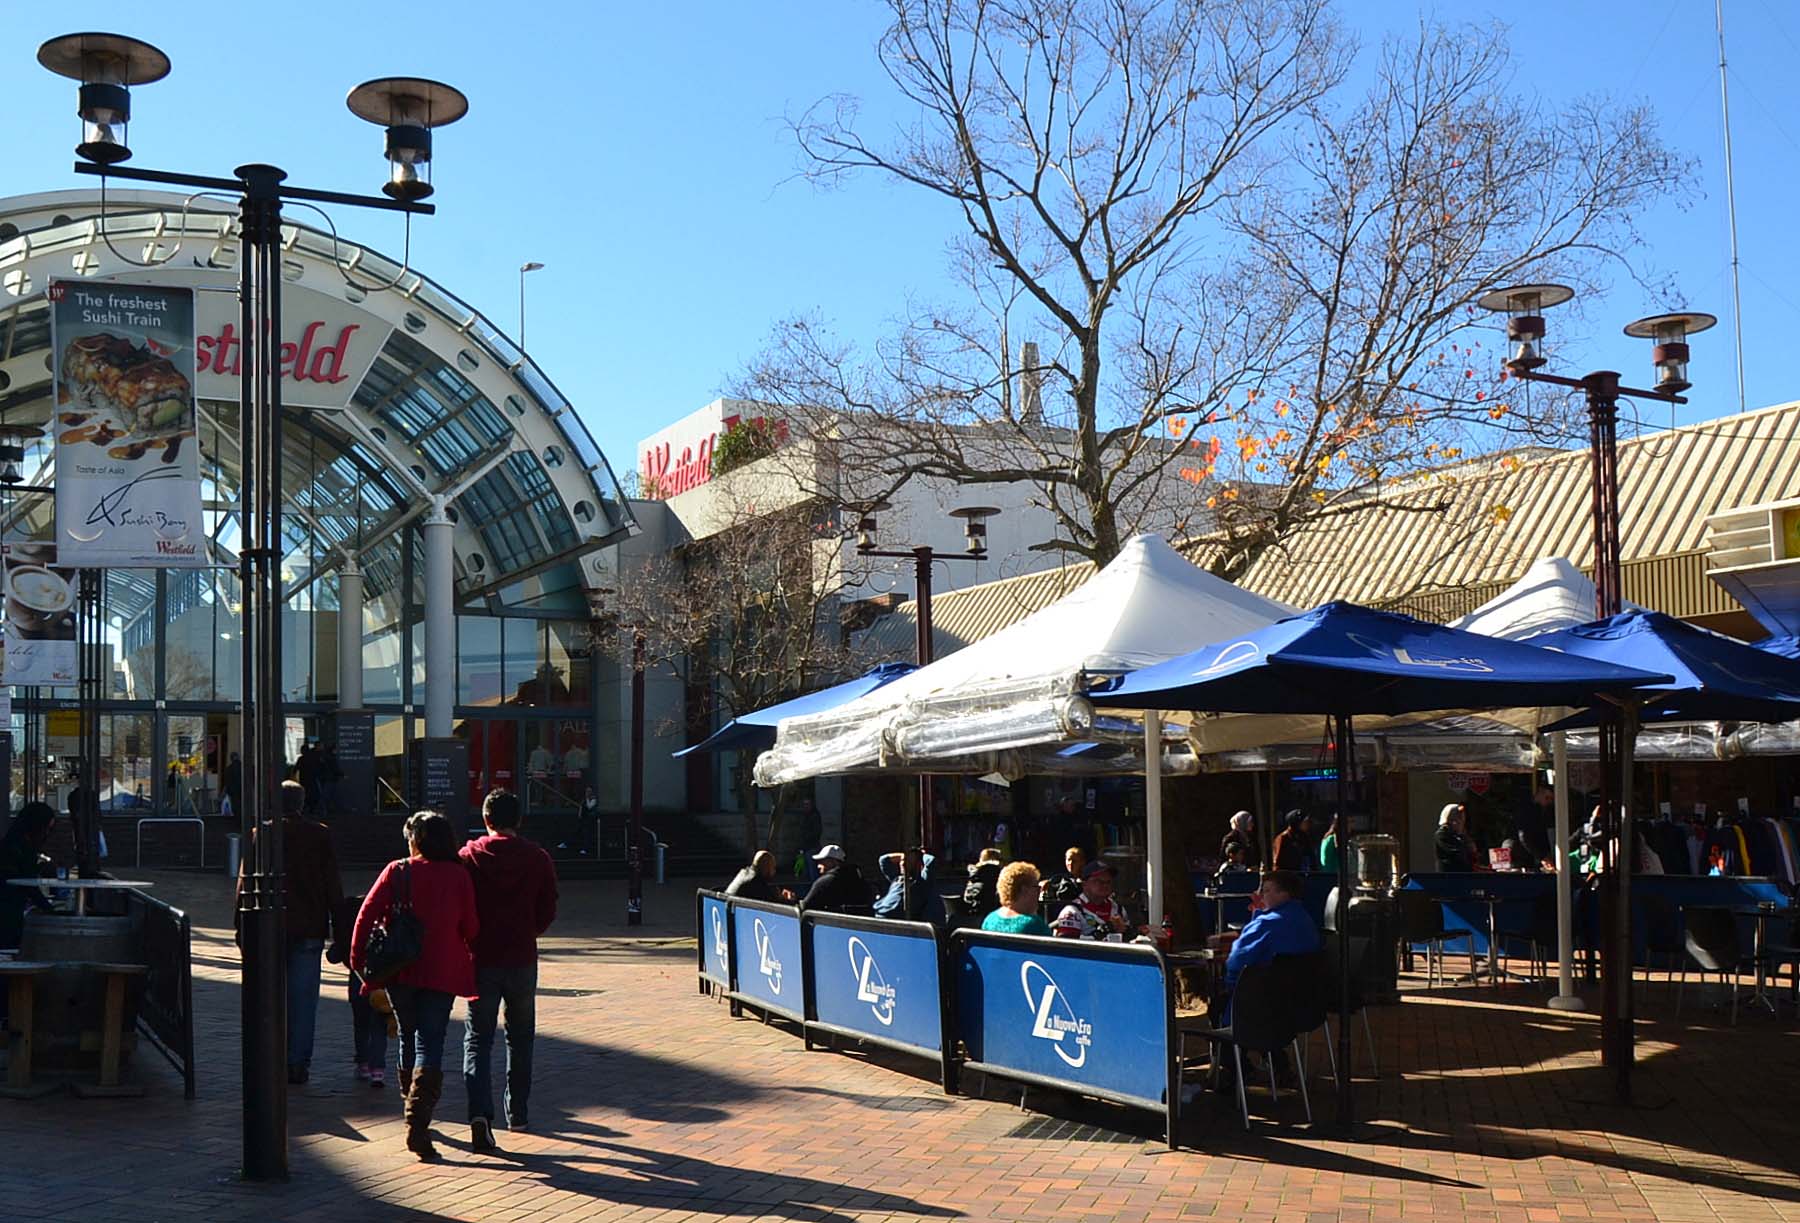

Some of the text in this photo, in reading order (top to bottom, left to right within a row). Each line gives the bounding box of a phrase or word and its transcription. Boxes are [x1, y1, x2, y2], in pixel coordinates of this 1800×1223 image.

[75, 292, 167, 311] The freshest
[82, 310, 161, 327] Sushi Train
[76, 465, 125, 474] Taste of Asia
[641, 432, 716, 500] Westfield
[120, 508, 153, 526] Sushi
[156, 541, 197, 555] Westfield
[1032, 984, 1065, 1041] La
[1078, 1018, 1092, 1036] Era
